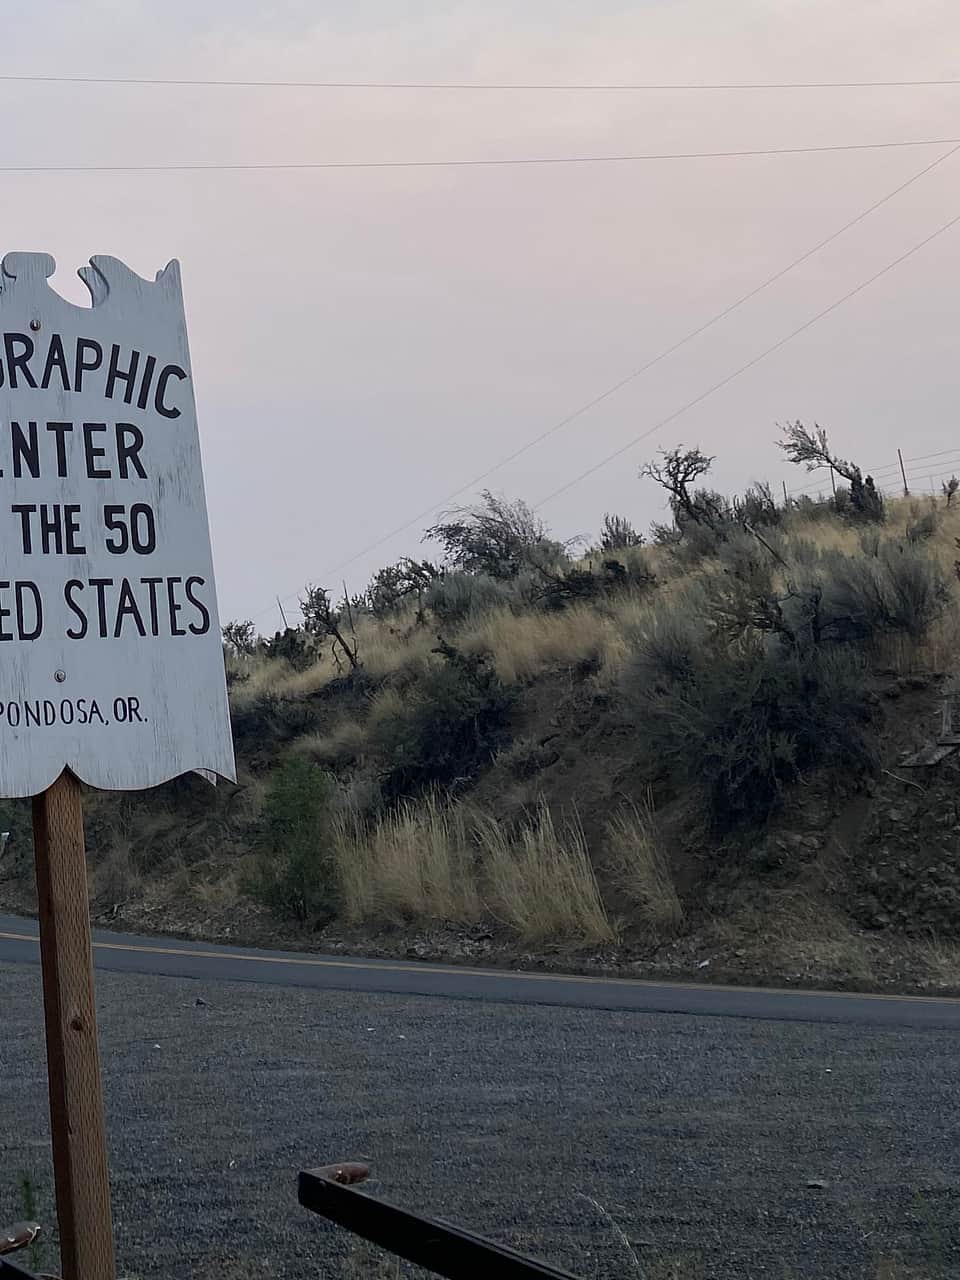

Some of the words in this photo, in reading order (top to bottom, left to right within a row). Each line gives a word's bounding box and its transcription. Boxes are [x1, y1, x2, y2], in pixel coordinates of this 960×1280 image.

[12, 504, 87, 555] THE
[105, 503, 157, 555] 50
[64, 575, 211, 640] STATES
[113, 696, 149, 723] OR.
